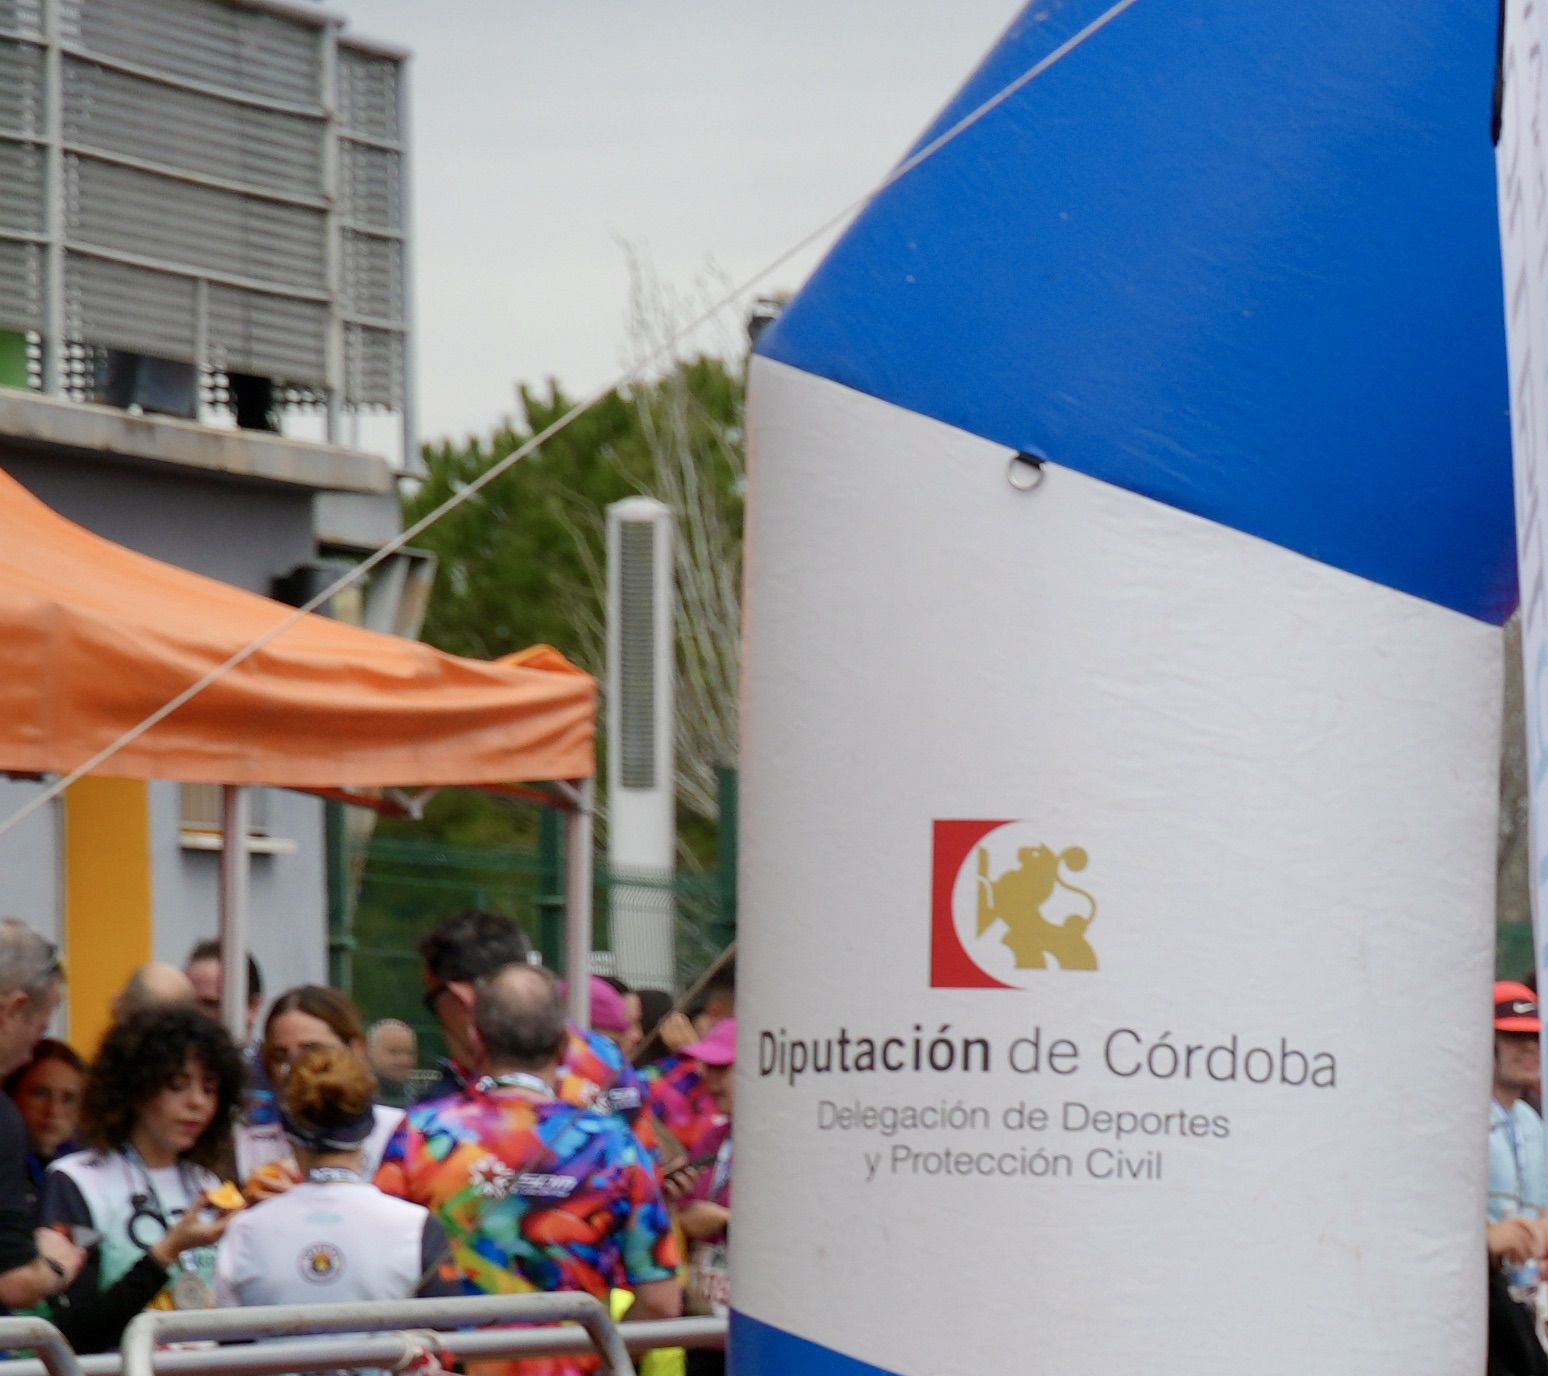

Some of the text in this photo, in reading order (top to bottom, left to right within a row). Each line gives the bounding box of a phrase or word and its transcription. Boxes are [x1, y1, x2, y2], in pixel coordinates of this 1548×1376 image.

[758, 1024, 1338, 1089] Diputación de Córdoba
[817, 1099, 1231, 1140] Delegación de Deportes
[864, 1145, 1163, 1182] y Protección Civil
